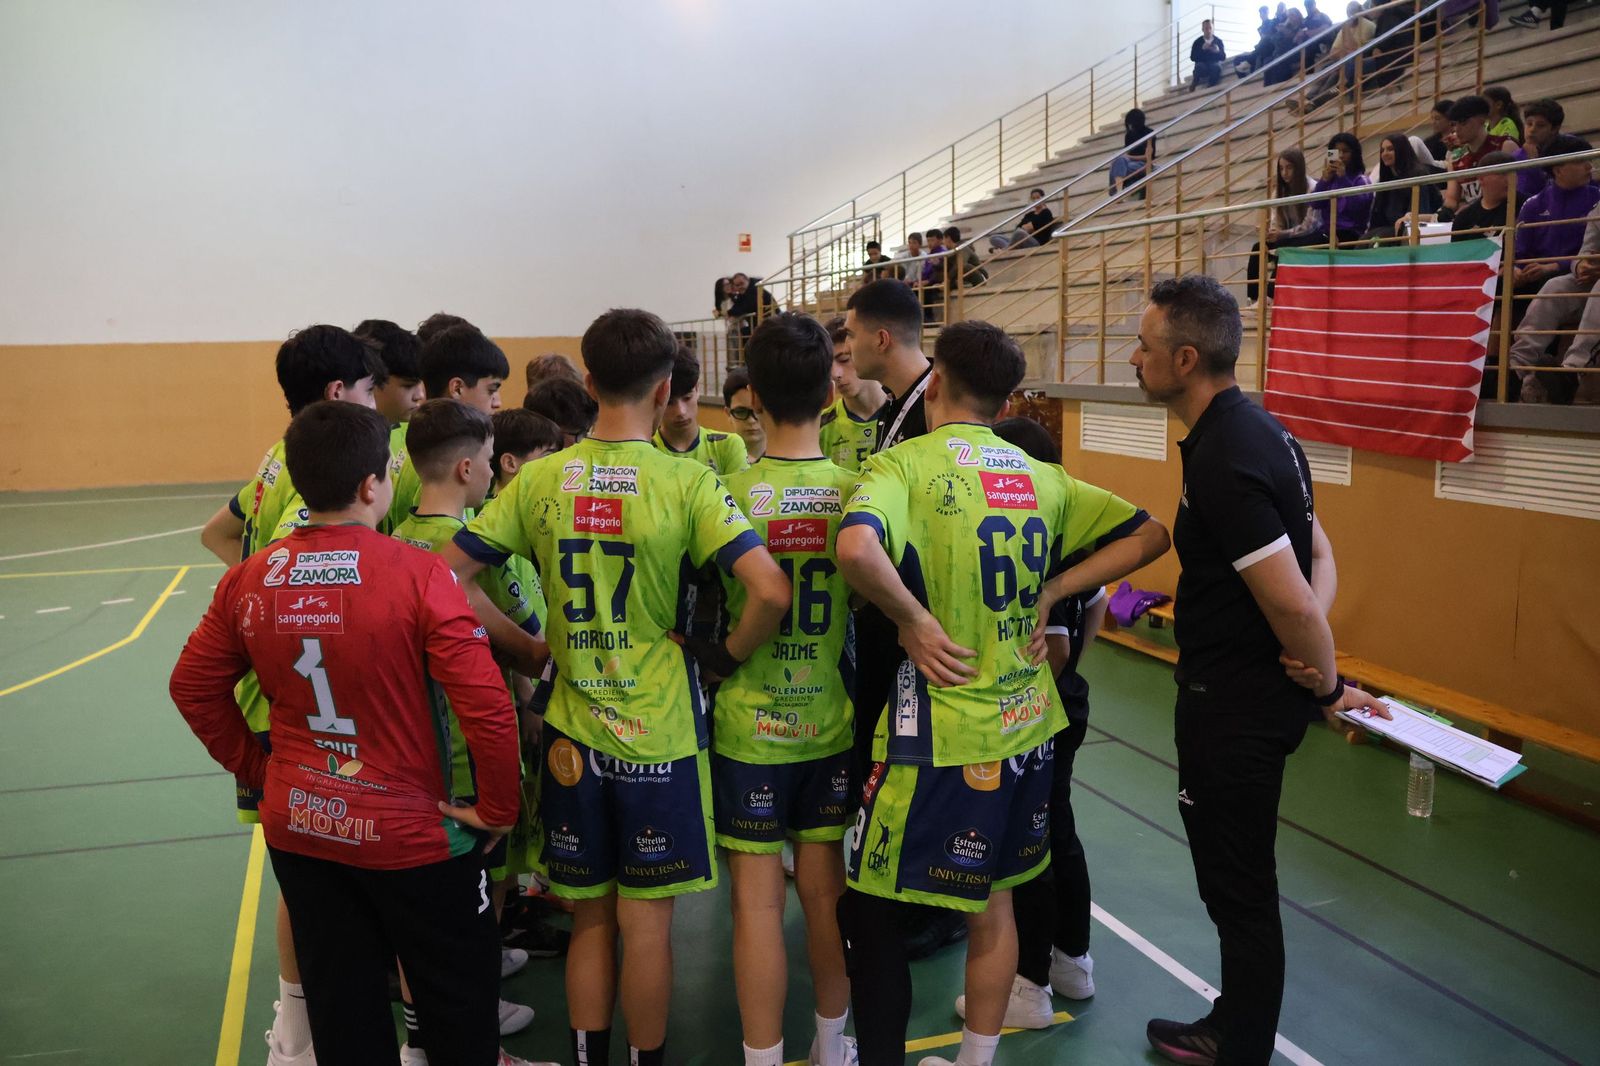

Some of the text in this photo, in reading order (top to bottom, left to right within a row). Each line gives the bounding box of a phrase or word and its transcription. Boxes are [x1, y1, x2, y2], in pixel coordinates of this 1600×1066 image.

[980, 446, 1020, 456] DIPUTACI
[588, 479, 638, 494] ZAMORA
[780, 501, 842, 514] ZAMORA
[769, 535, 825, 548] sangregorio
[976, 515, 1049, 613] 69
[290, 567, 359, 583] ZAMORA
[558, 537, 635, 623] 57
[779, 557, 837, 636] 16
[277, 611, 340, 626] sangregorio
[771, 642, 819, 661] JAIME
[293, 638, 358, 736] 1
[570, 678, 637, 688] MOLENDUM
[763, 684, 824, 695] MOLENDUM
[755, 708, 798, 726] PRO
[756, 720, 820, 738] MOVIL
[288, 787, 348, 820] PRO
[289, 807, 381, 842] MOVIL
[550, 829, 580, 844] Estrella
[636, 836, 667, 845] Estrella
[953, 836, 987, 851] Estrella
[550, 838, 578, 852] Galicia
[638, 843, 667, 853] Galicia
[952, 845, 984, 859] Galicia
[624, 859, 690, 876] UNIVERSAL
